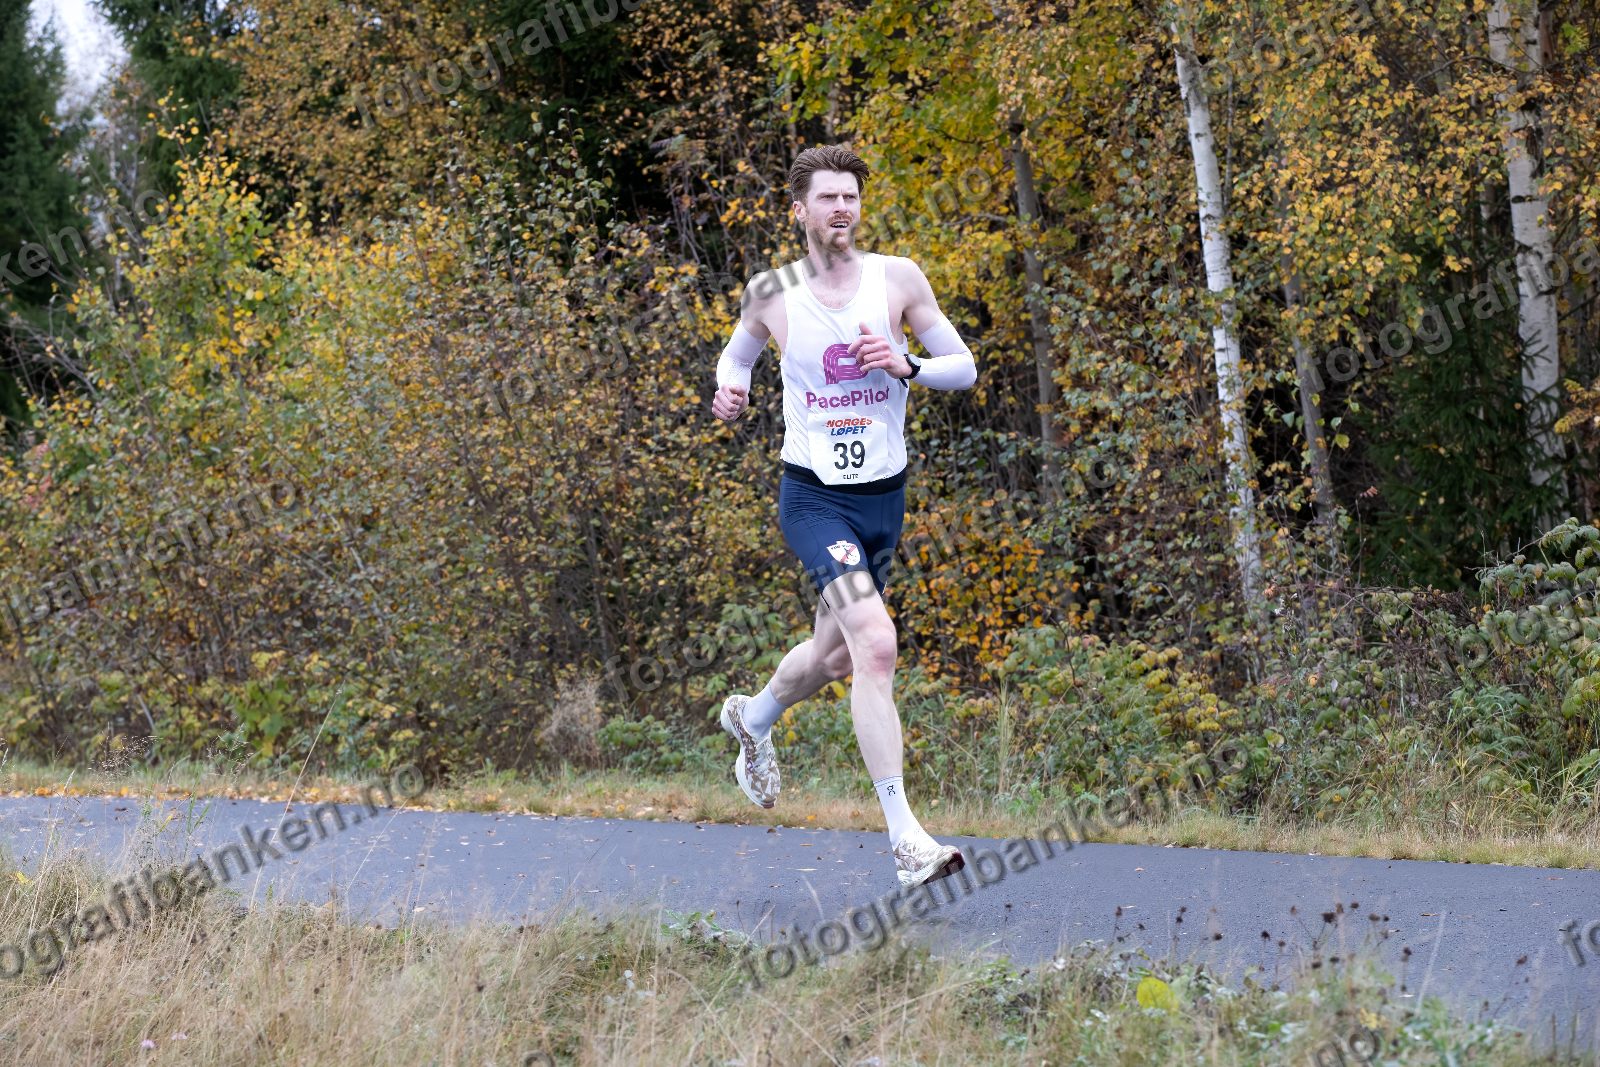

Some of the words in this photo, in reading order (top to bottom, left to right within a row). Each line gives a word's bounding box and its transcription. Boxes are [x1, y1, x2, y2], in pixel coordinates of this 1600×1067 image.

[806, 386, 890, 409] PacePilot
[826, 417, 873, 428] NORGES
[831, 426, 867, 436] LØPET
[833, 440, 866, 470] 39
